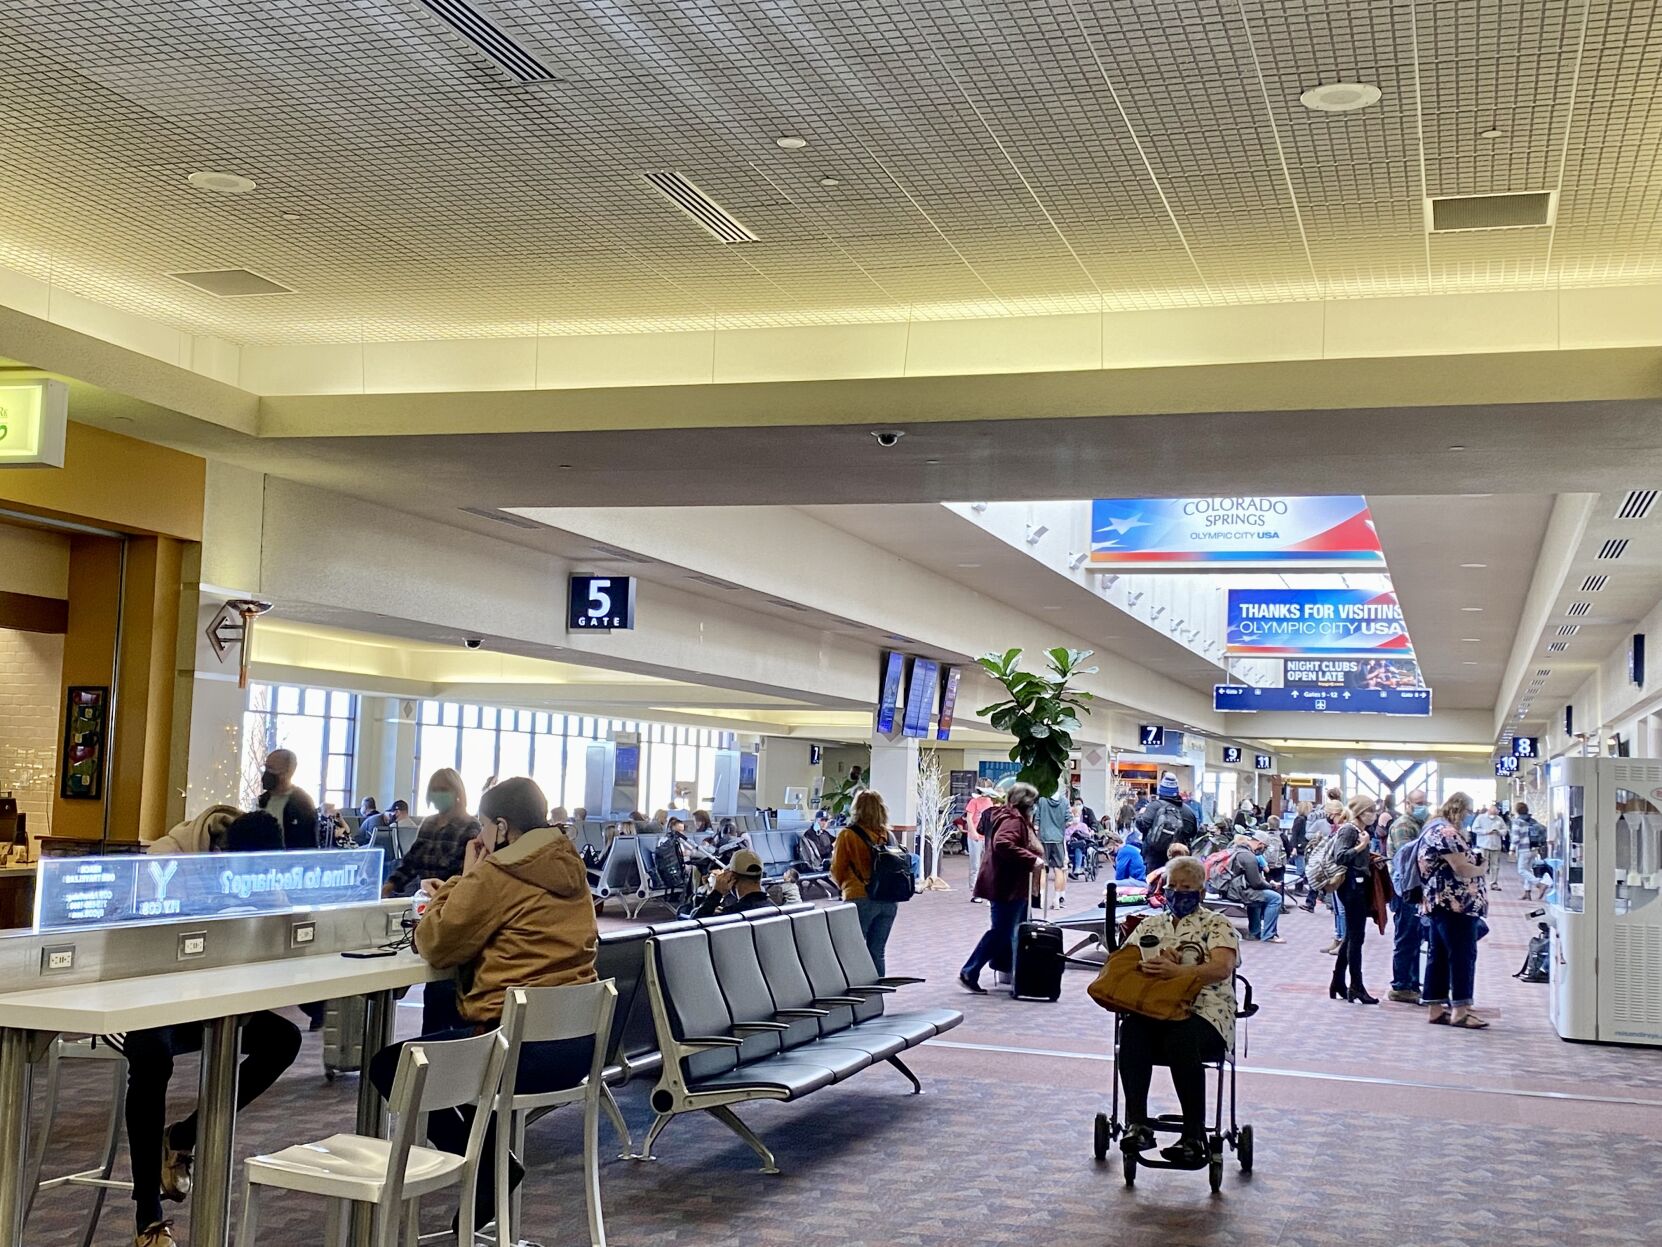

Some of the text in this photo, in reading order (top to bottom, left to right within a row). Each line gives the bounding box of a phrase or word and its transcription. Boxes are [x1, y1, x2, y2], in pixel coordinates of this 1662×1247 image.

[1183, 497, 1288, 515] COLORADO
[1205, 513, 1265, 528] SPRINGS
[1190, 532, 1232, 540] OLYMPIC
[1233, 532, 1256, 540] CITY
[587, 579, 611, 618] 5
[1239, 603, 1301, 619] THANKS
[1304, 604, 1335, 619] FOR
[578, 617, 620, 626] GATE
[1239, 621, 1403, 635] OLYMPIC CITY USA
[1287, 660, 1358, 672] NIGHT CLUBS
[1287, 671, 1345, 682] OPEN LATE
[1147, 726, 1157, 741] 7
[1518, 738, 1531, 753] 8
[1228, 748, 1238, 760] 9
[1257, 756, 1269, 767] 11
[1501, 756, 1518, 768] 10
